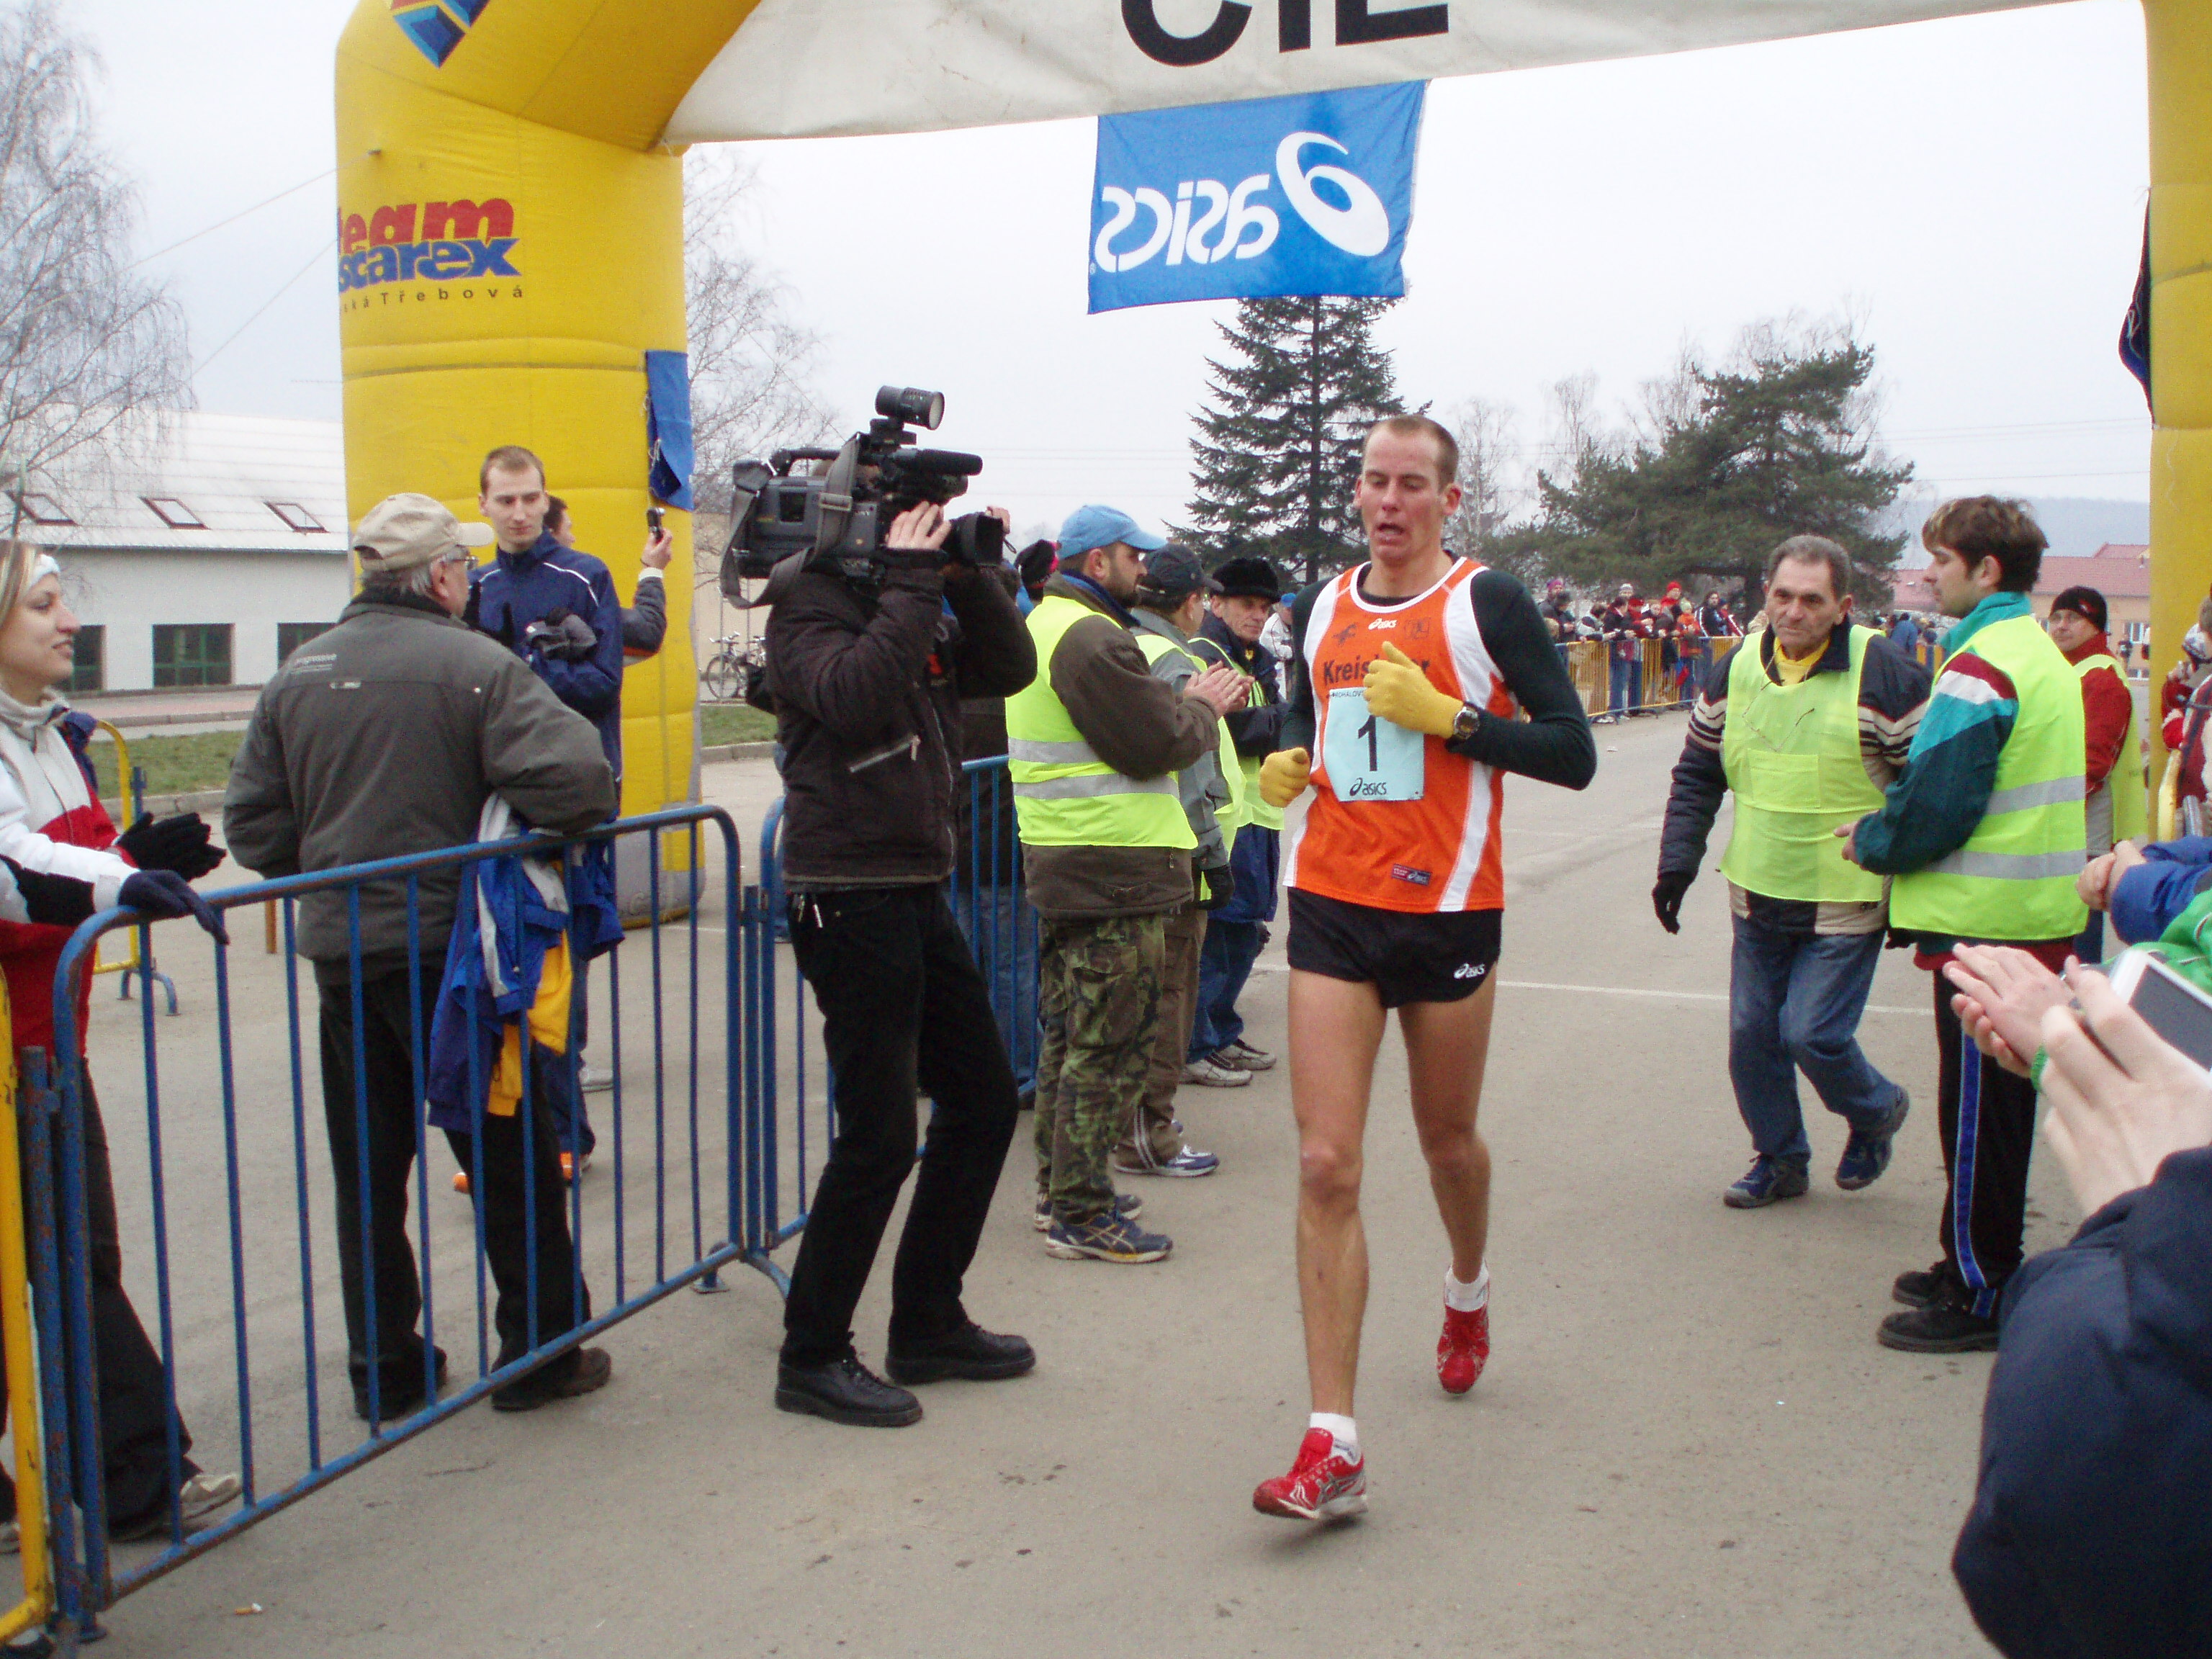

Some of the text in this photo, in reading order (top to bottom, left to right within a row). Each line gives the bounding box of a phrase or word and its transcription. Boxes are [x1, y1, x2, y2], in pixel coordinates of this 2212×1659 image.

[338, 198, 515, 255] eam
[381, 286, 523, 305] Třebová
[1358, 715, 1378, 772] 1
